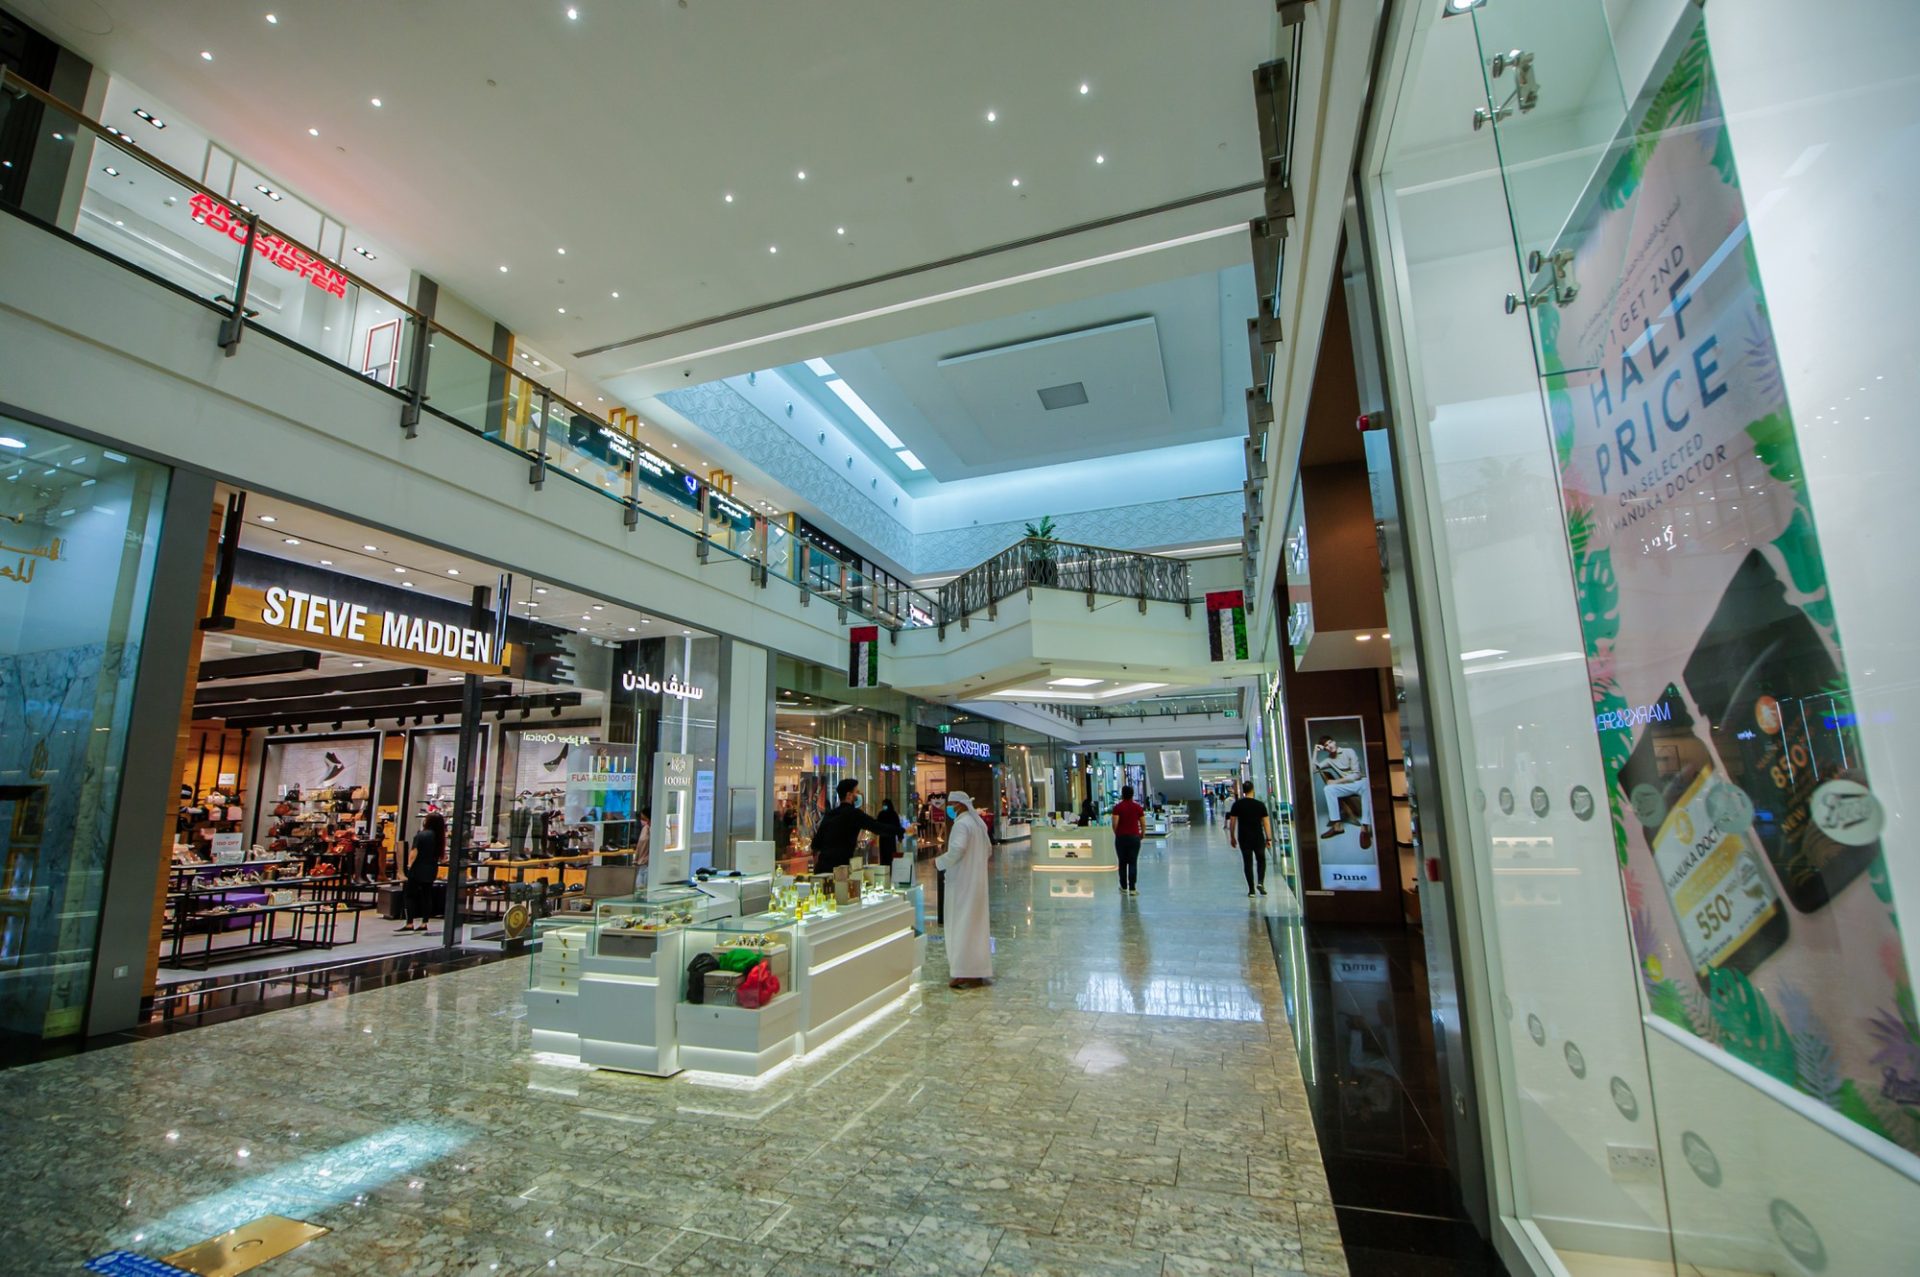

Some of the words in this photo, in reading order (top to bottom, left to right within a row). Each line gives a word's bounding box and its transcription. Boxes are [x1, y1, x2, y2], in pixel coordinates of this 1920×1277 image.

[1619, 290, 1646, 332] GET
[1651, 244, 1684, 295] 2ND
[1590, 268, 1692, 429] HALF
[1596, 334, 1729, 495] PRICE
[1619, 484, 1638, 508] ON
[1640, 433, 1704, 493] SELECTED
[1666, 444, 1727, 499] DOCTOR
[261, 586, 369, 642] STEVE
[381, 611, 491, 664] MADDEN
[622, 669, 661, 694] مادن
[571, 773, 590, 782] FLAT
[592, 773, 607, 782] AED
[1332, 873, 1368, 881] Dune
